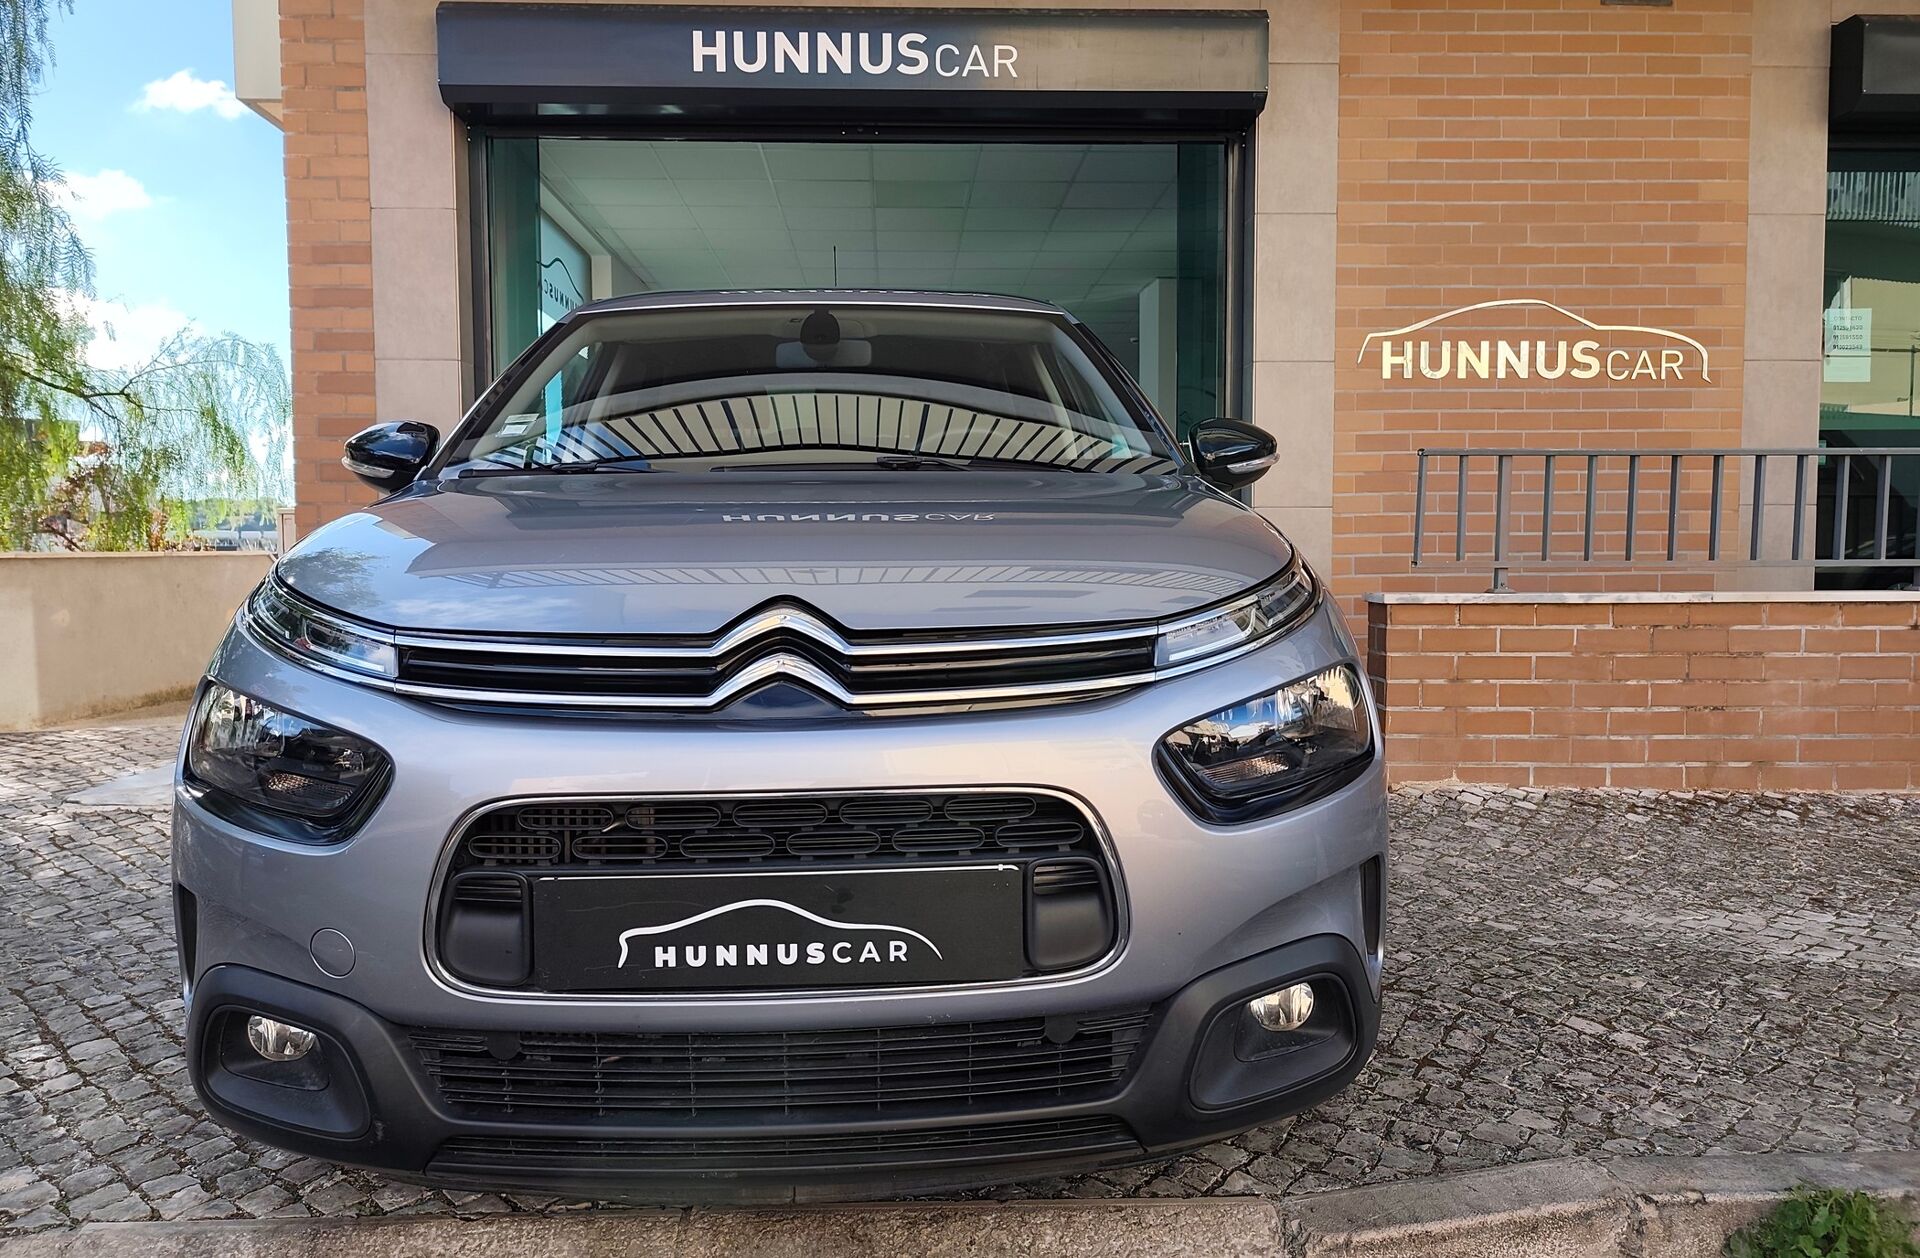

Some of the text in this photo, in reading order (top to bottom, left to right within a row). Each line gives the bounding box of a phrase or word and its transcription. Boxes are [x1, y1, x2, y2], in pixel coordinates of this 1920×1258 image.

[692, 30, 1018, 79] HUNNUSCAR
[1382, 340, 1684, 381] HUNNUSCAR
[654, 940, 908, 968] HUNNUSCAR
